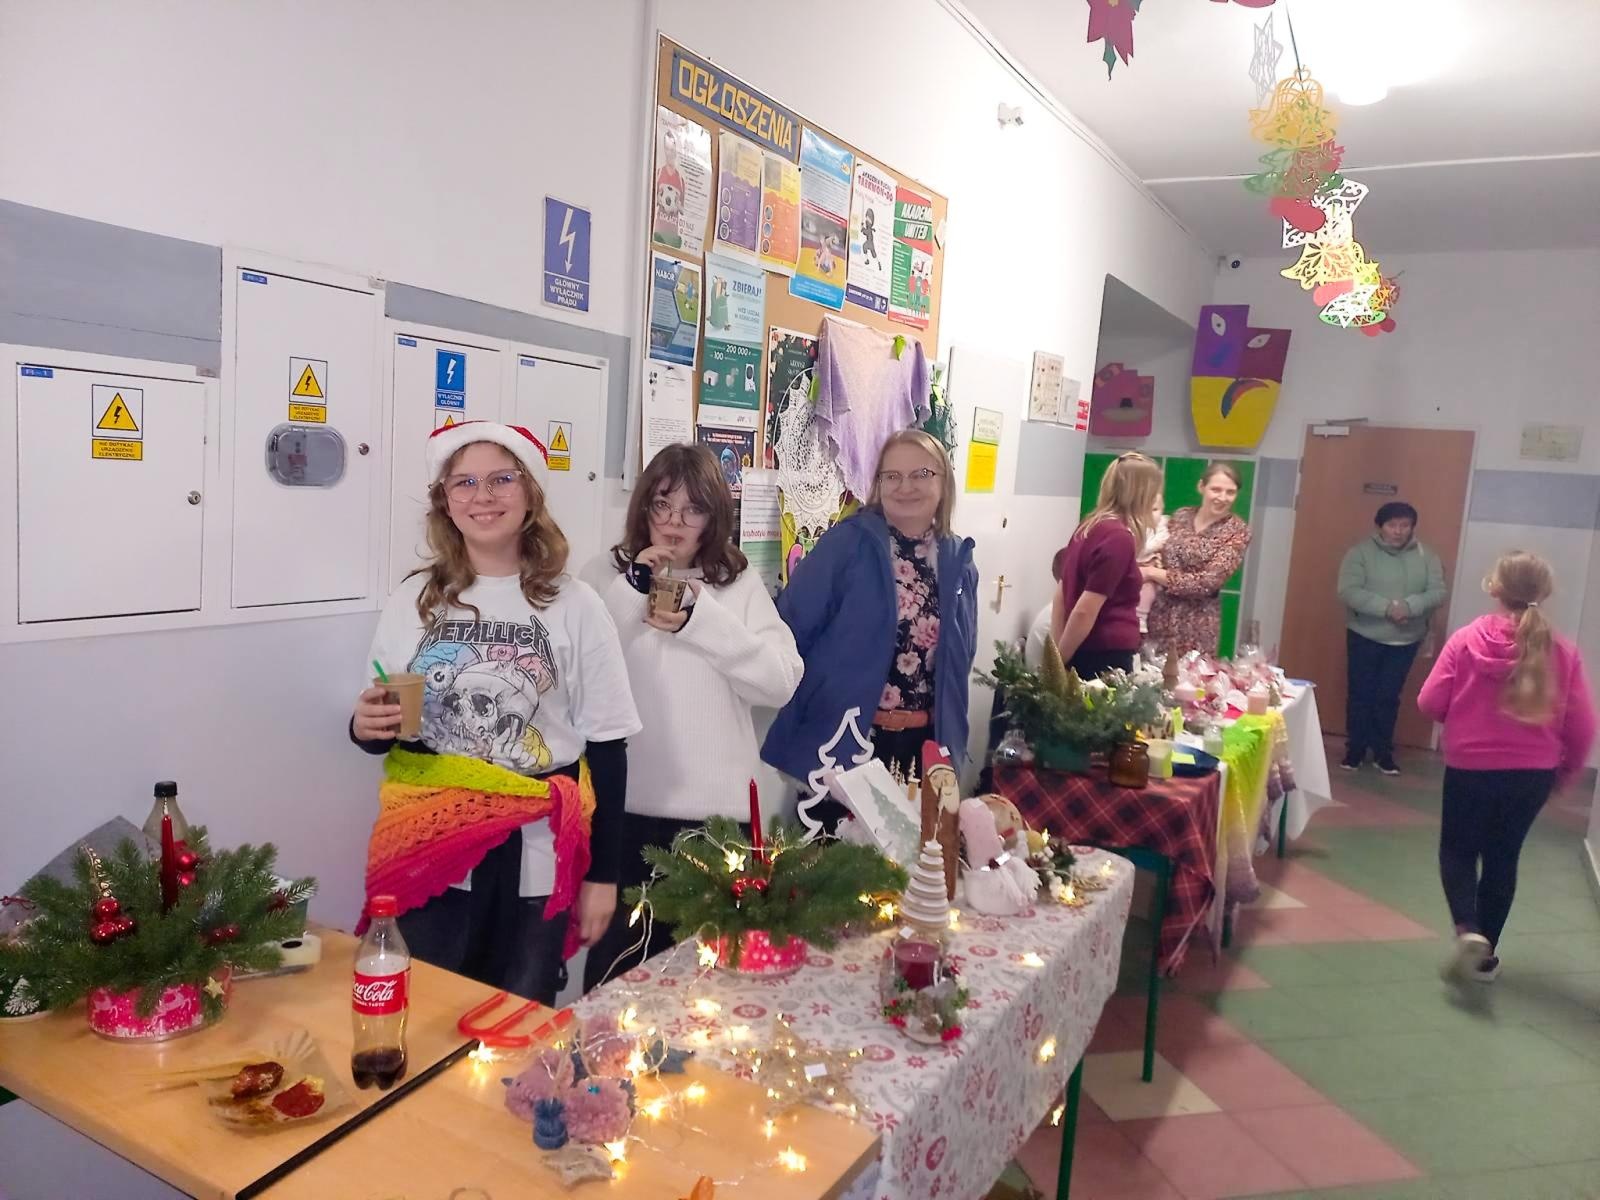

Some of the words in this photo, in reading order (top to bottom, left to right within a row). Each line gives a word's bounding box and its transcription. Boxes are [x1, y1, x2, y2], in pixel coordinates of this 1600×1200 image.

[679, 59, 792, 152] OGŁOSZENIA
[904, 222, 929, 240] UNITED
[714, 351, 724, 360] 100
[726, 344, 737, 354] 200
[737, 347, 748, 356] 000
[354, 980, 397, 1001] ca-Cola
